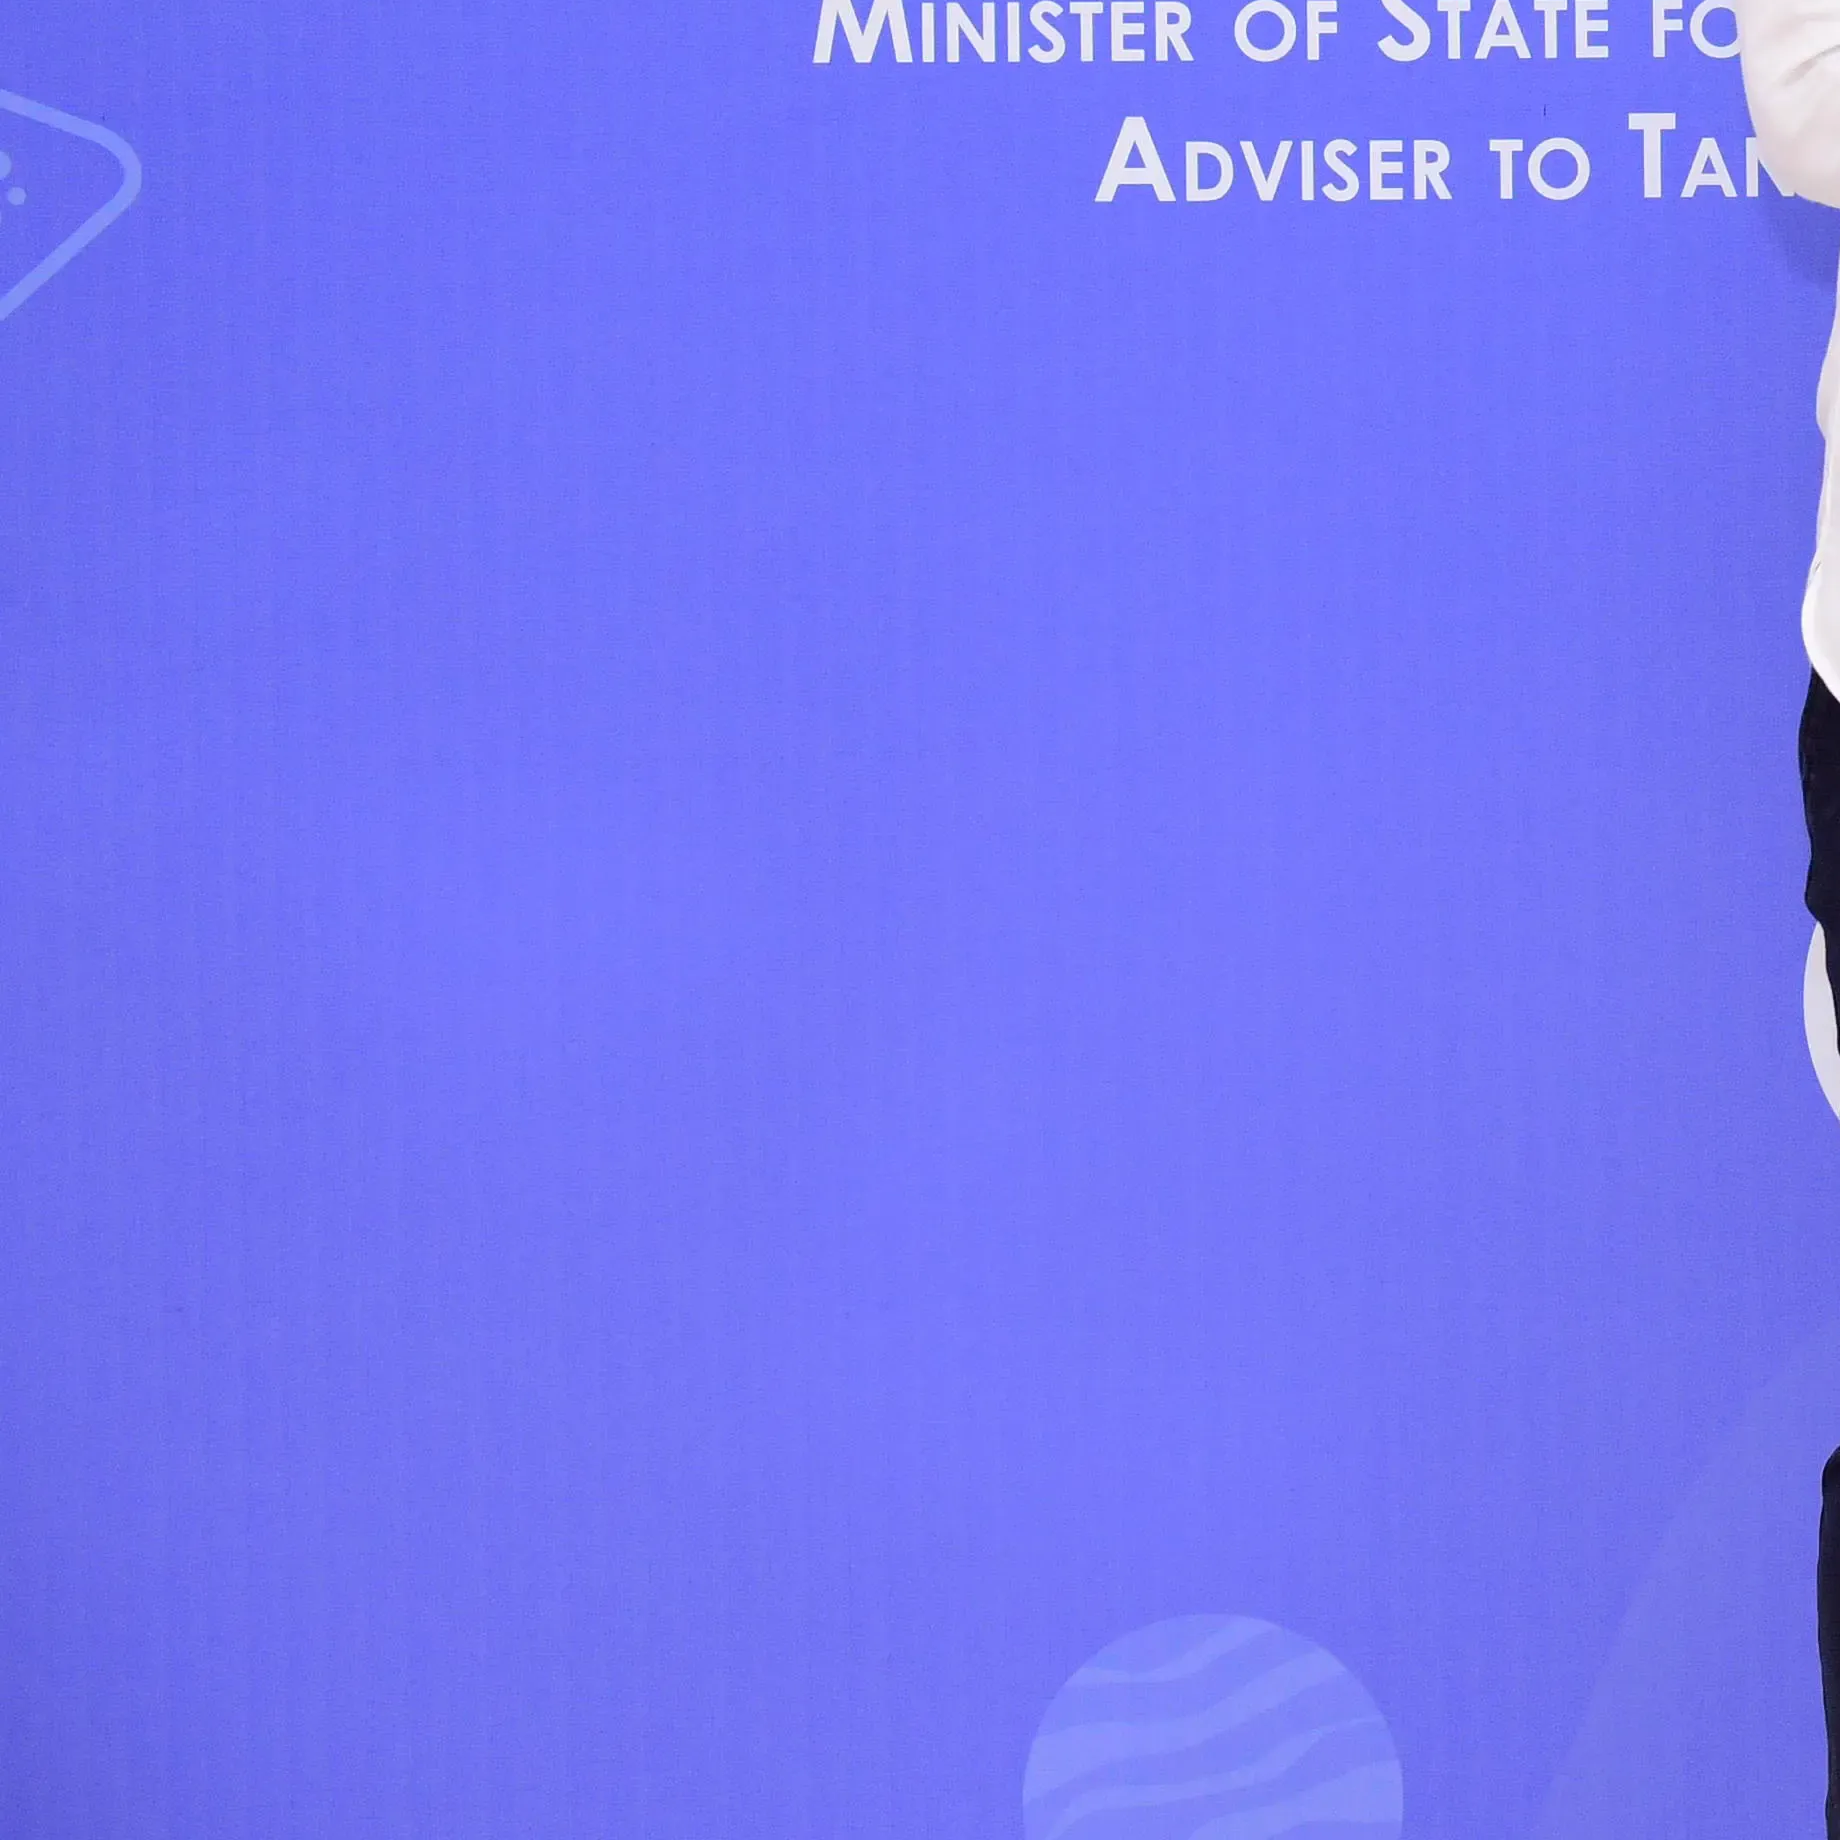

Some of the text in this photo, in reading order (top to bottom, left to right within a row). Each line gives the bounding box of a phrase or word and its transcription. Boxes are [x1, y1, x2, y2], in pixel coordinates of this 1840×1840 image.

[1234, 0, 1338, 63] OF
[1094, 116, 1454, 202] ADVISER
[1490, 138, 1592, 201] TO
